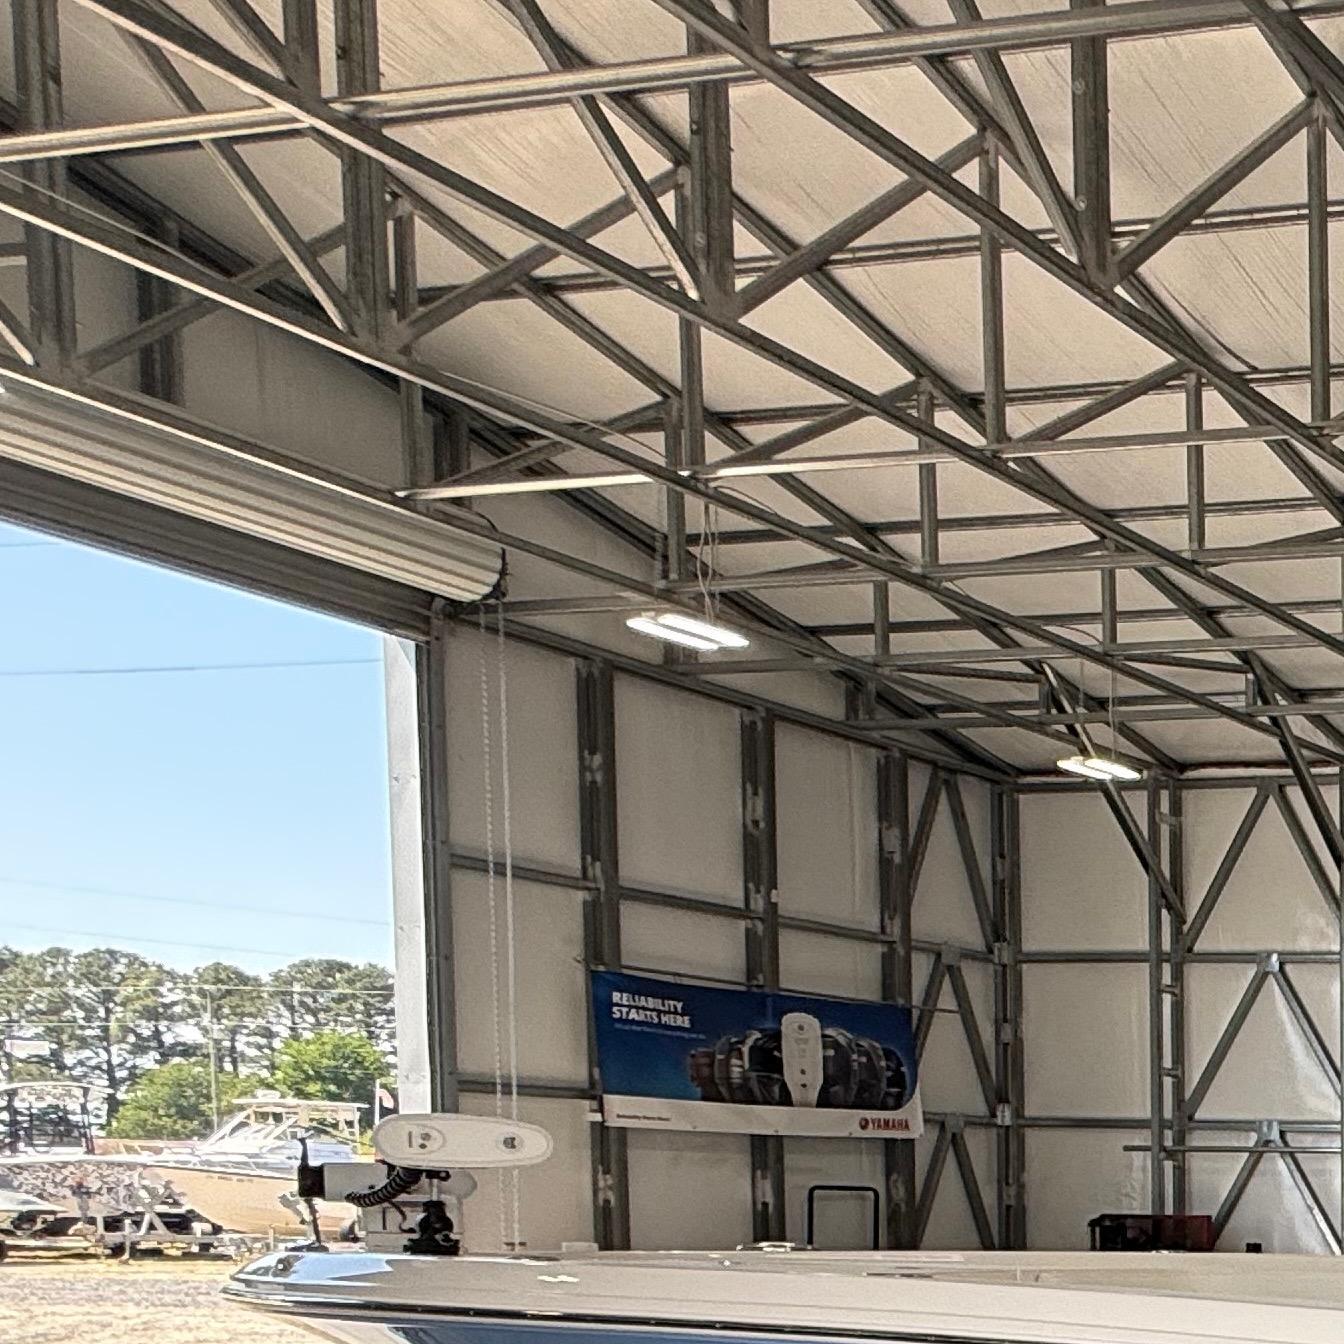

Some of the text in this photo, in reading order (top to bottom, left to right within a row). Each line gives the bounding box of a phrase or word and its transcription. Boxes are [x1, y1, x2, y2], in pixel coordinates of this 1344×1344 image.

[612, 991, 683, 1013] RELIABILITY
[612, 1006, 691, 1028] STARTS HERE
[870, 1118, 911, 1131] YAMAHA
